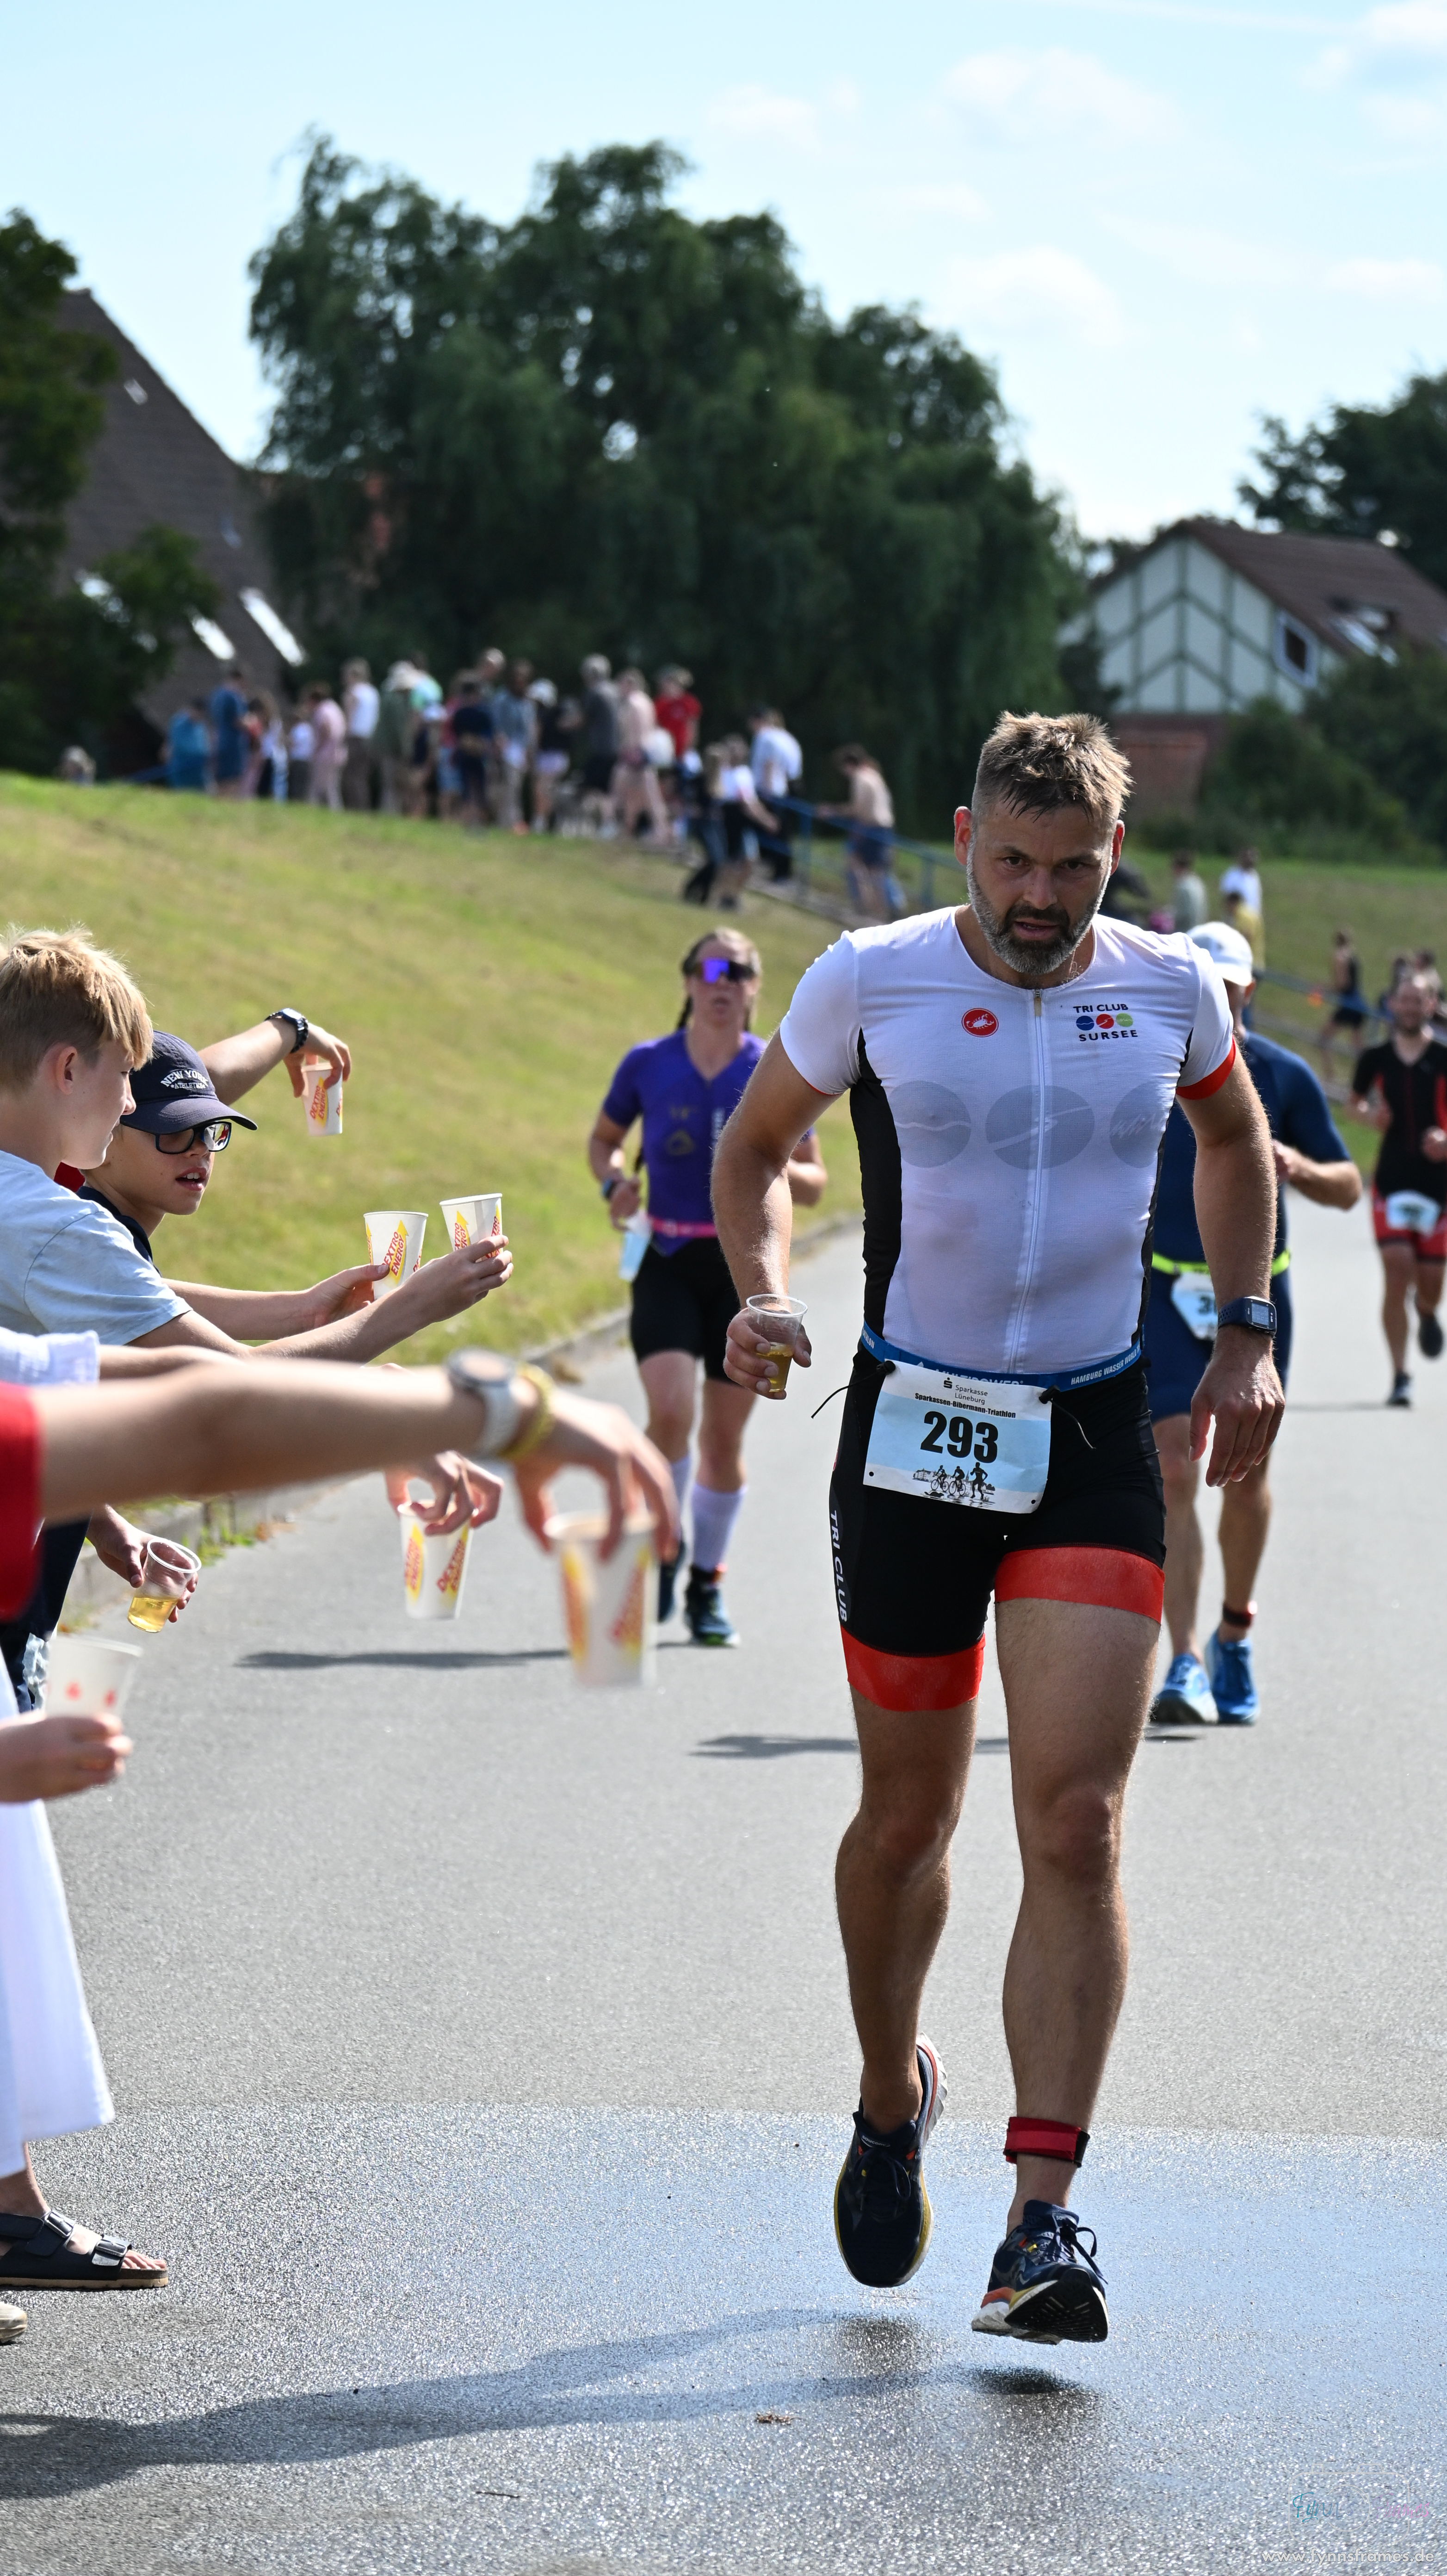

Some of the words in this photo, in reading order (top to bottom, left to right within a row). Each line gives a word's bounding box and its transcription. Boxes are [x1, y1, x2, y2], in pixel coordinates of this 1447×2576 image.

[1073, 1005, 1093, 1013] TRI
[1096, 1003, 1129, 1012] CLUB
[1079, 1030, 1138, 1041] SURSEE
[160, 1071, 184, 1087] NEW
[184, 1070, 209, 1087] YORK
[381, 1231, 399, 1267] EXTRO
[391, 1234, 404, 1276] ENERGY
[1071, 1370, 1102, 1385] HAMBURG
[1104, 1359, 1124, 1375] WASSER
[1125, 1349, 1137, 1365] WORLD
[955, 1385, 988, 1396] Sparkasse
[955, 1392, 985, 1405] Lüneburg
[915, 1393, 1016, 1418] Sparkassen-Bibermann-Triathlon
[920, 1411, 998, 1463] 293
[830, 1510, 840, 1549] TRI
[835, 1556, 847, 1622] CLUB
